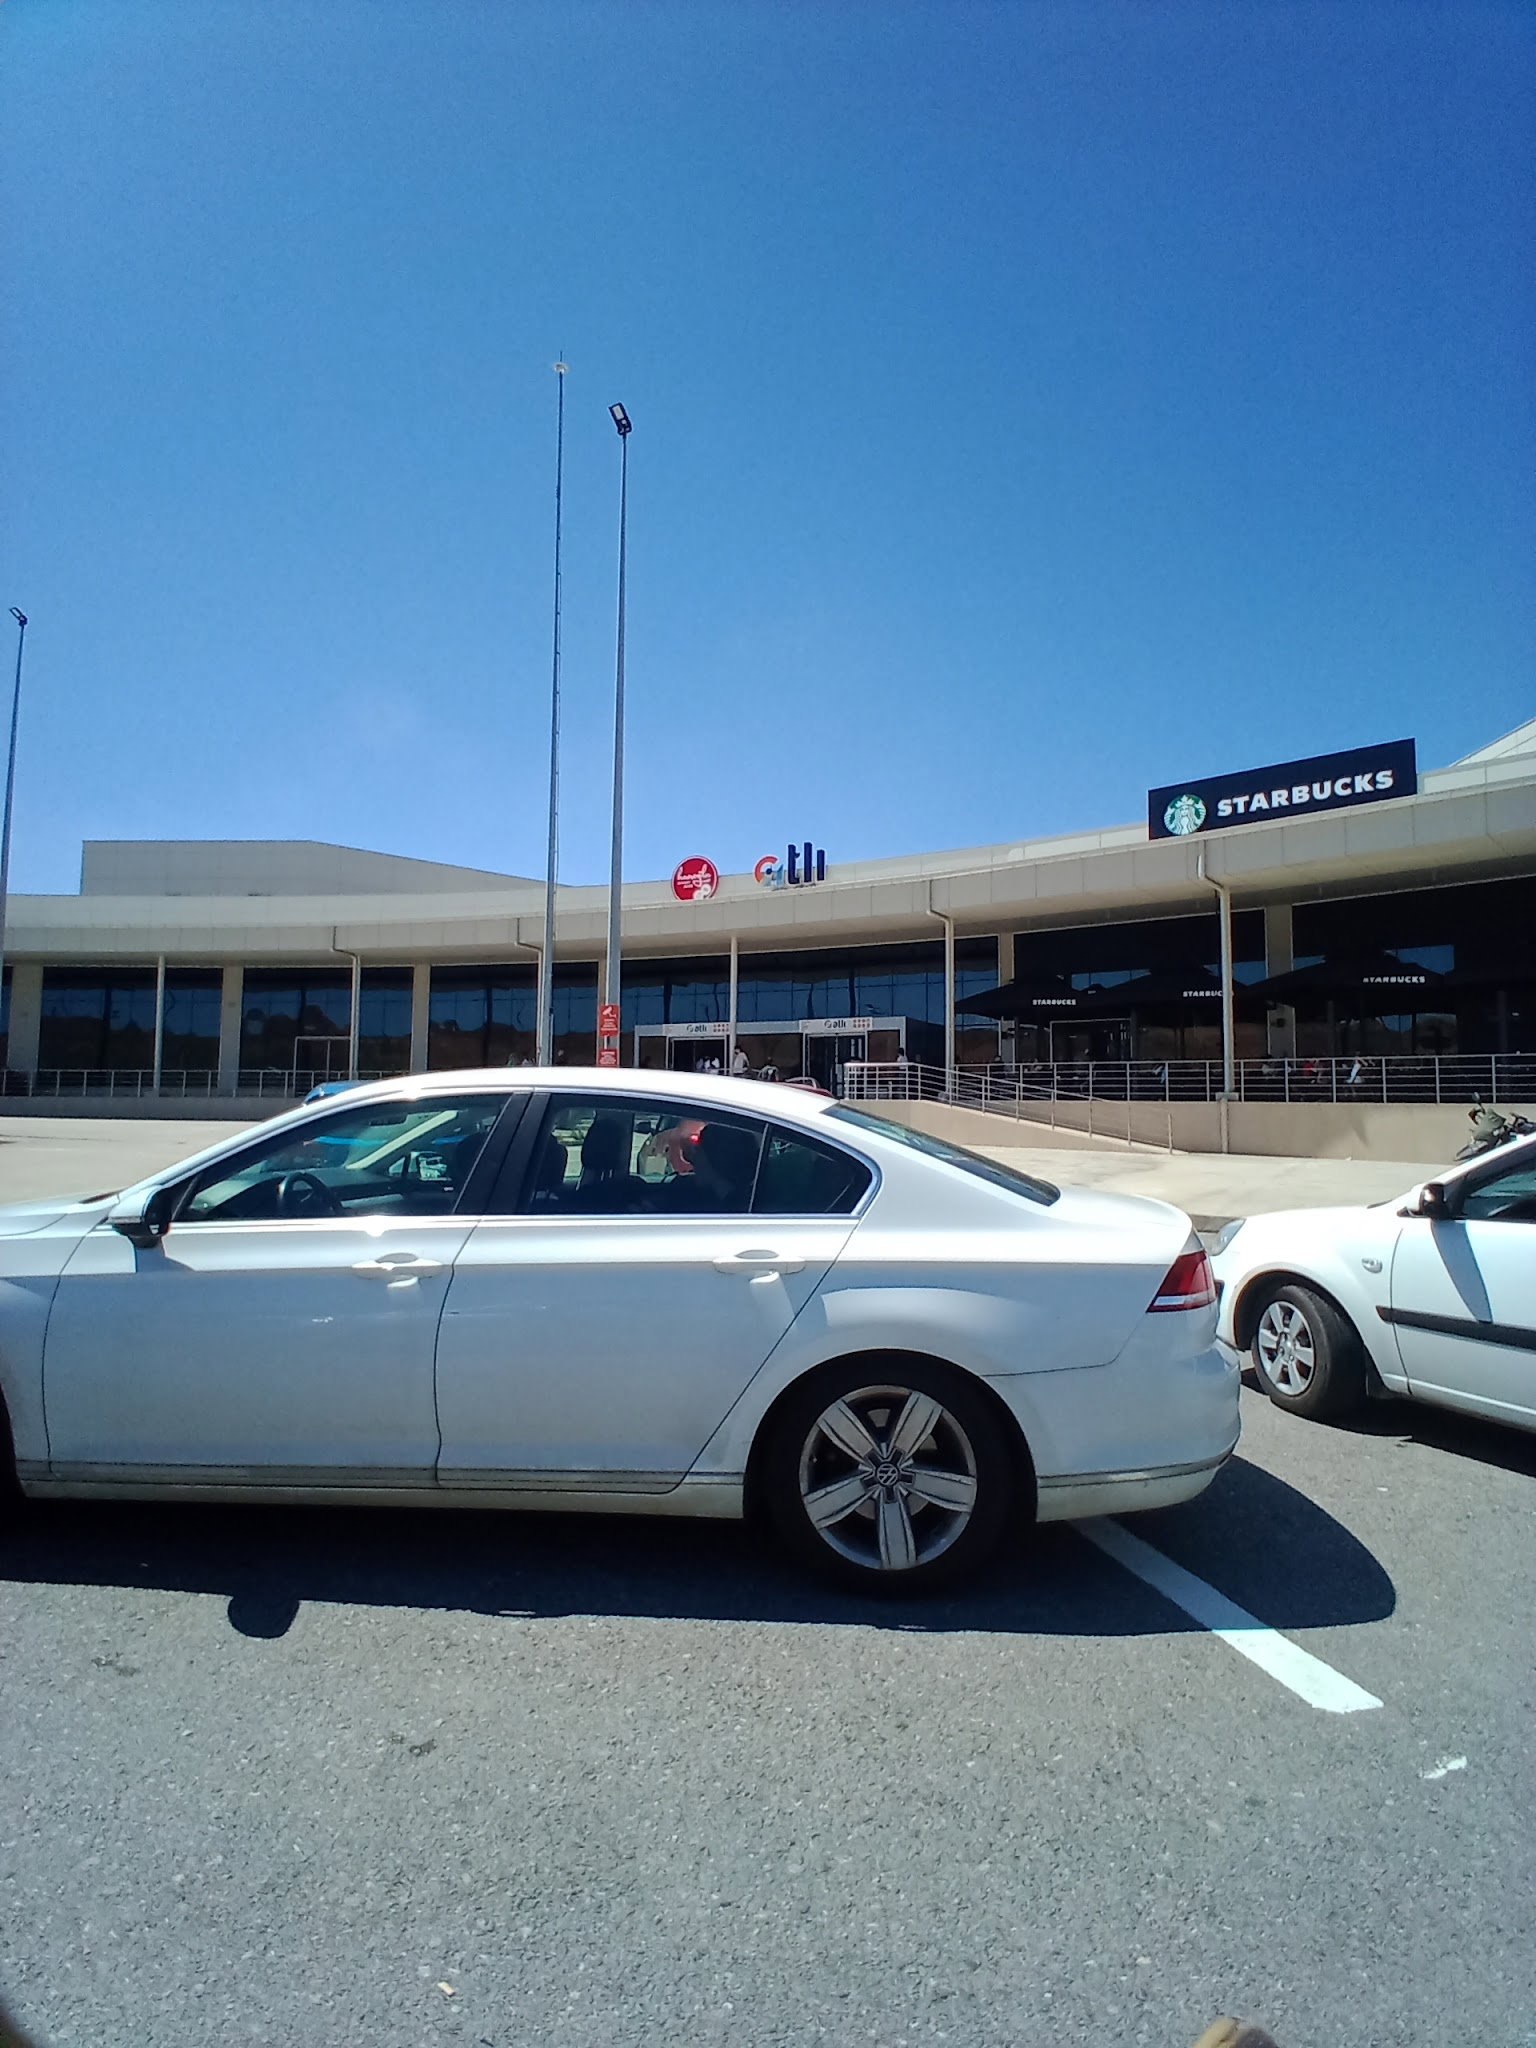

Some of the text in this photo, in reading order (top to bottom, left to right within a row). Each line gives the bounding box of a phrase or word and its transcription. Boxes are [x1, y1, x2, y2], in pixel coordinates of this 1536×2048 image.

[1217, 769, 1394, 817] STARBUCKS
[1362, 975, 1426, 984] STARBUCKS
[1182, 990, 1224, 998] STARBUC
[1032, 998, 1077, 1007] STARBUCKS
